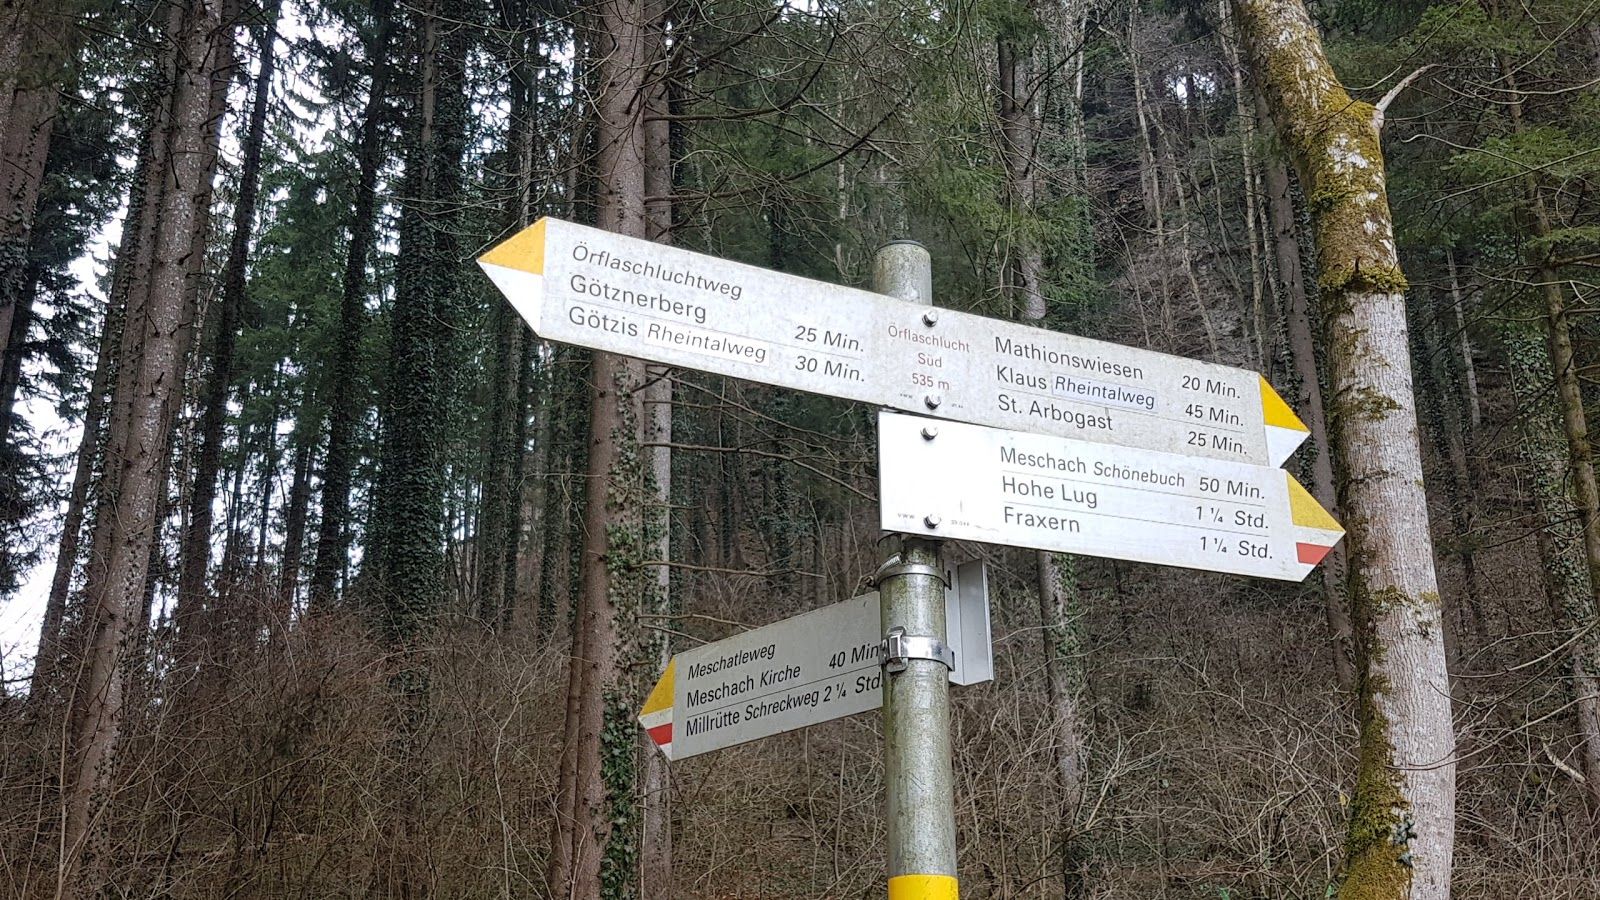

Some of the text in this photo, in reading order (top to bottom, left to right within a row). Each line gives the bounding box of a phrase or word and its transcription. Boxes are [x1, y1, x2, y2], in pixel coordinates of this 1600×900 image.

[573, 241, 743, 300] Örflaschluchtweg
[570, 274, 864, 352] Götznerberg 25 Min.
[888, 322, 970, 352] Örflaschlucht
[568, 305, 866, 382] Götzis Rheintalweg 30 Min.
[918, 352, 942, 368] Süd
[995, 336, 1240, 399] Mathionswiesen 20 Min.
[912, 373, 950, 390] 535 m
[996, 364, 1244, 427] Klaus Rheintalweg 45 Min.
[998, 394, 1248, 455] St. Arbogast 25 Min.
[1000, 446, 1265, 500] Meschach Schönebuch 50 Min.
[1002, 475, 1054, 500] Hohe
[1062, 484, 1098, 510] Lug
[1234, 510, 1269, 530] Std.
[1004, 506, 1080, 534] Fraxern
[1238, 540, 1273, 560] Std.
[687, 642, 776, 680] Meschatleweg
[687, 675, 754, 708] Meschach
[760, 664, 801, 686] Kirche
[829, 652, 846, 669] 40
[686, 708, 740, 737] Millrütte
[744, 689, 819, 722] Schreckweg
[855, 672, 884, 694] Std.
